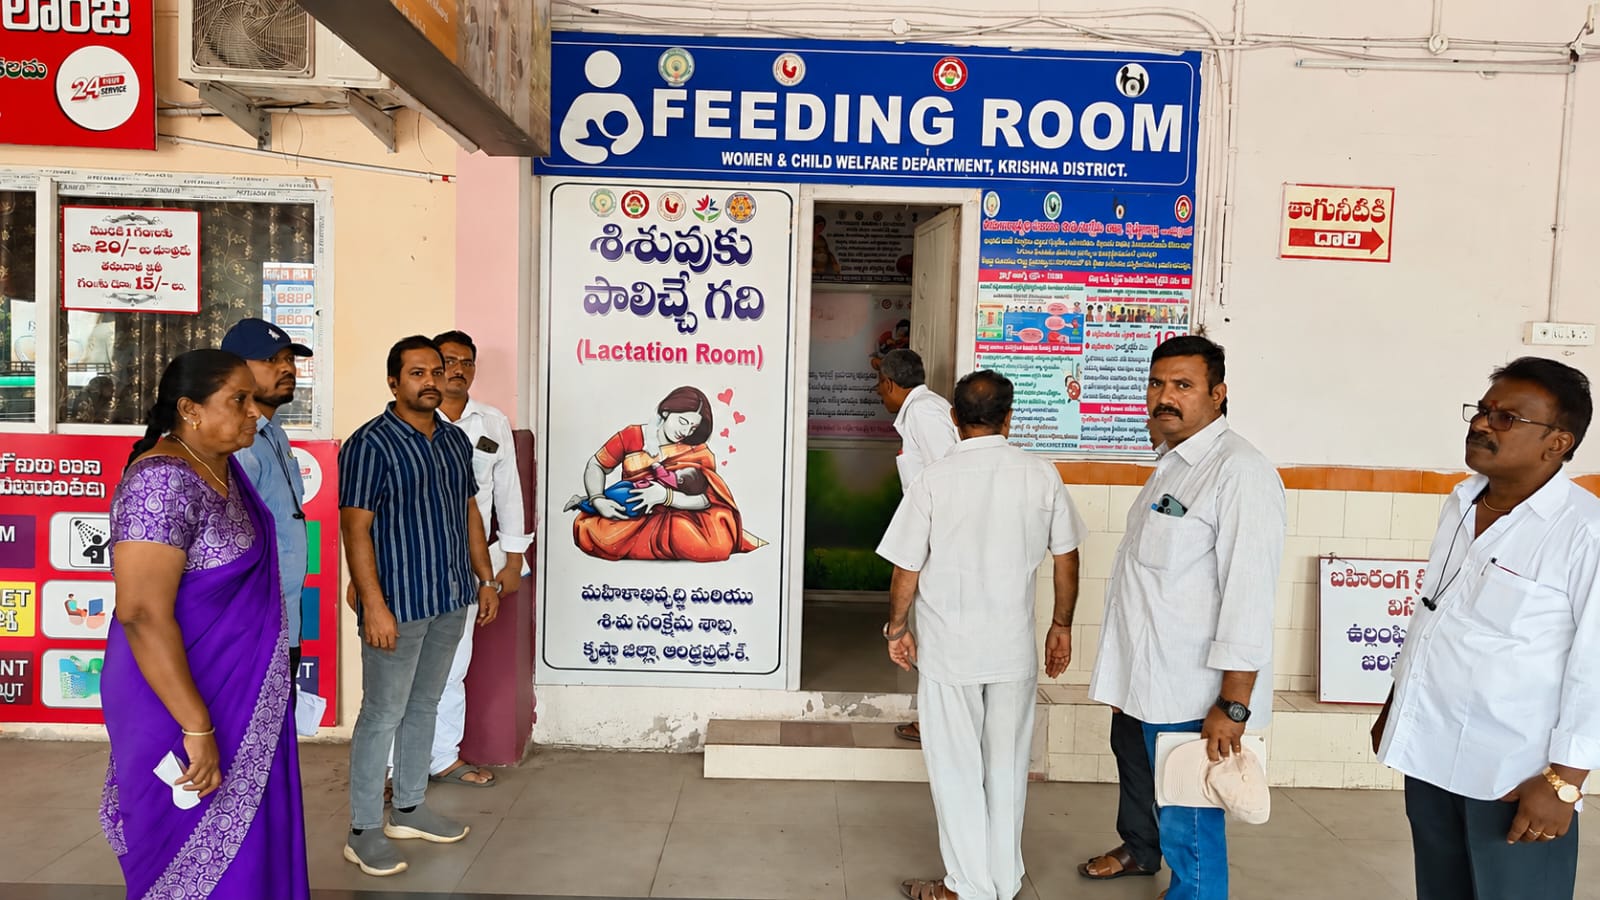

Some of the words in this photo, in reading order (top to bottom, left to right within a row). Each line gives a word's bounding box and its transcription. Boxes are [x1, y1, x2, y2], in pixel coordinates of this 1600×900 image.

[71, 77, 101, 101] 24
[101, 86, 127, 95] SERVICE
[652, 88, 955, 147] FEEDING
[982, 98, 1184, 153] ROOM
[721, 151, 773, 168] WOMEN
[778, 153, 789, 167] &
[792, 153, 832, 170] CHILD
[835, 154, 898, 171] WELFARE
[901, 156, 994, 175] DEPARTMENT,
[998, 160, 1060, 176] KRISHNA
[1063, 161, 1128, 177] DISTRICT.
[126, 228, 132, 237] 1
[95, 238, 137, 257] 20/-
[590, 223, 753, 274] శిశువుకు
[135, 275, 169, 292] 15/-
[583, 270, 699, 335] పాలిచ్చే
[705, 279, 765, 321] గది
[576, 338, 688, 365] (Lactation
[696, 343, 764, 371] Room)
[691, 587, 754, 605] మరియు
